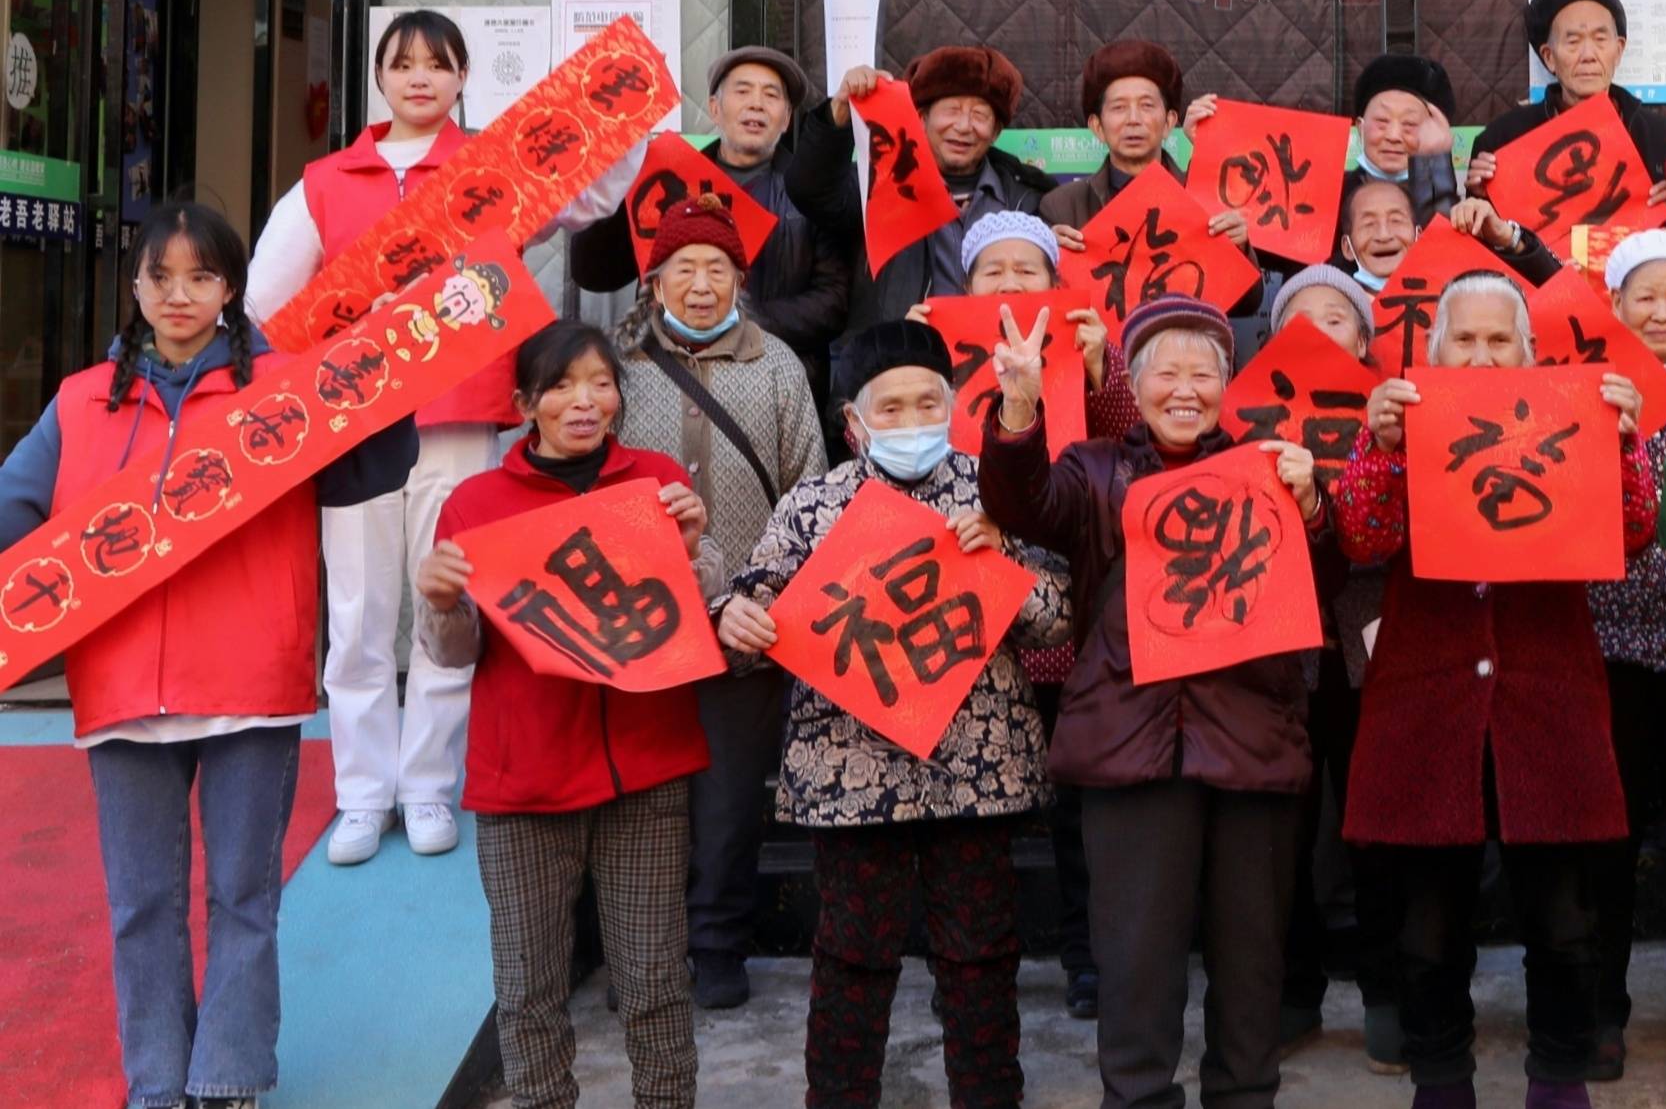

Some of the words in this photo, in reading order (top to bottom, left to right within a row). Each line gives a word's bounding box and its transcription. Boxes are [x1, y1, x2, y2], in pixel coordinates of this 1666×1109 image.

[10, 44, 34, 97] 推
[498, 525, 683, 679] 福
[811, 536, 988, 708] 福
